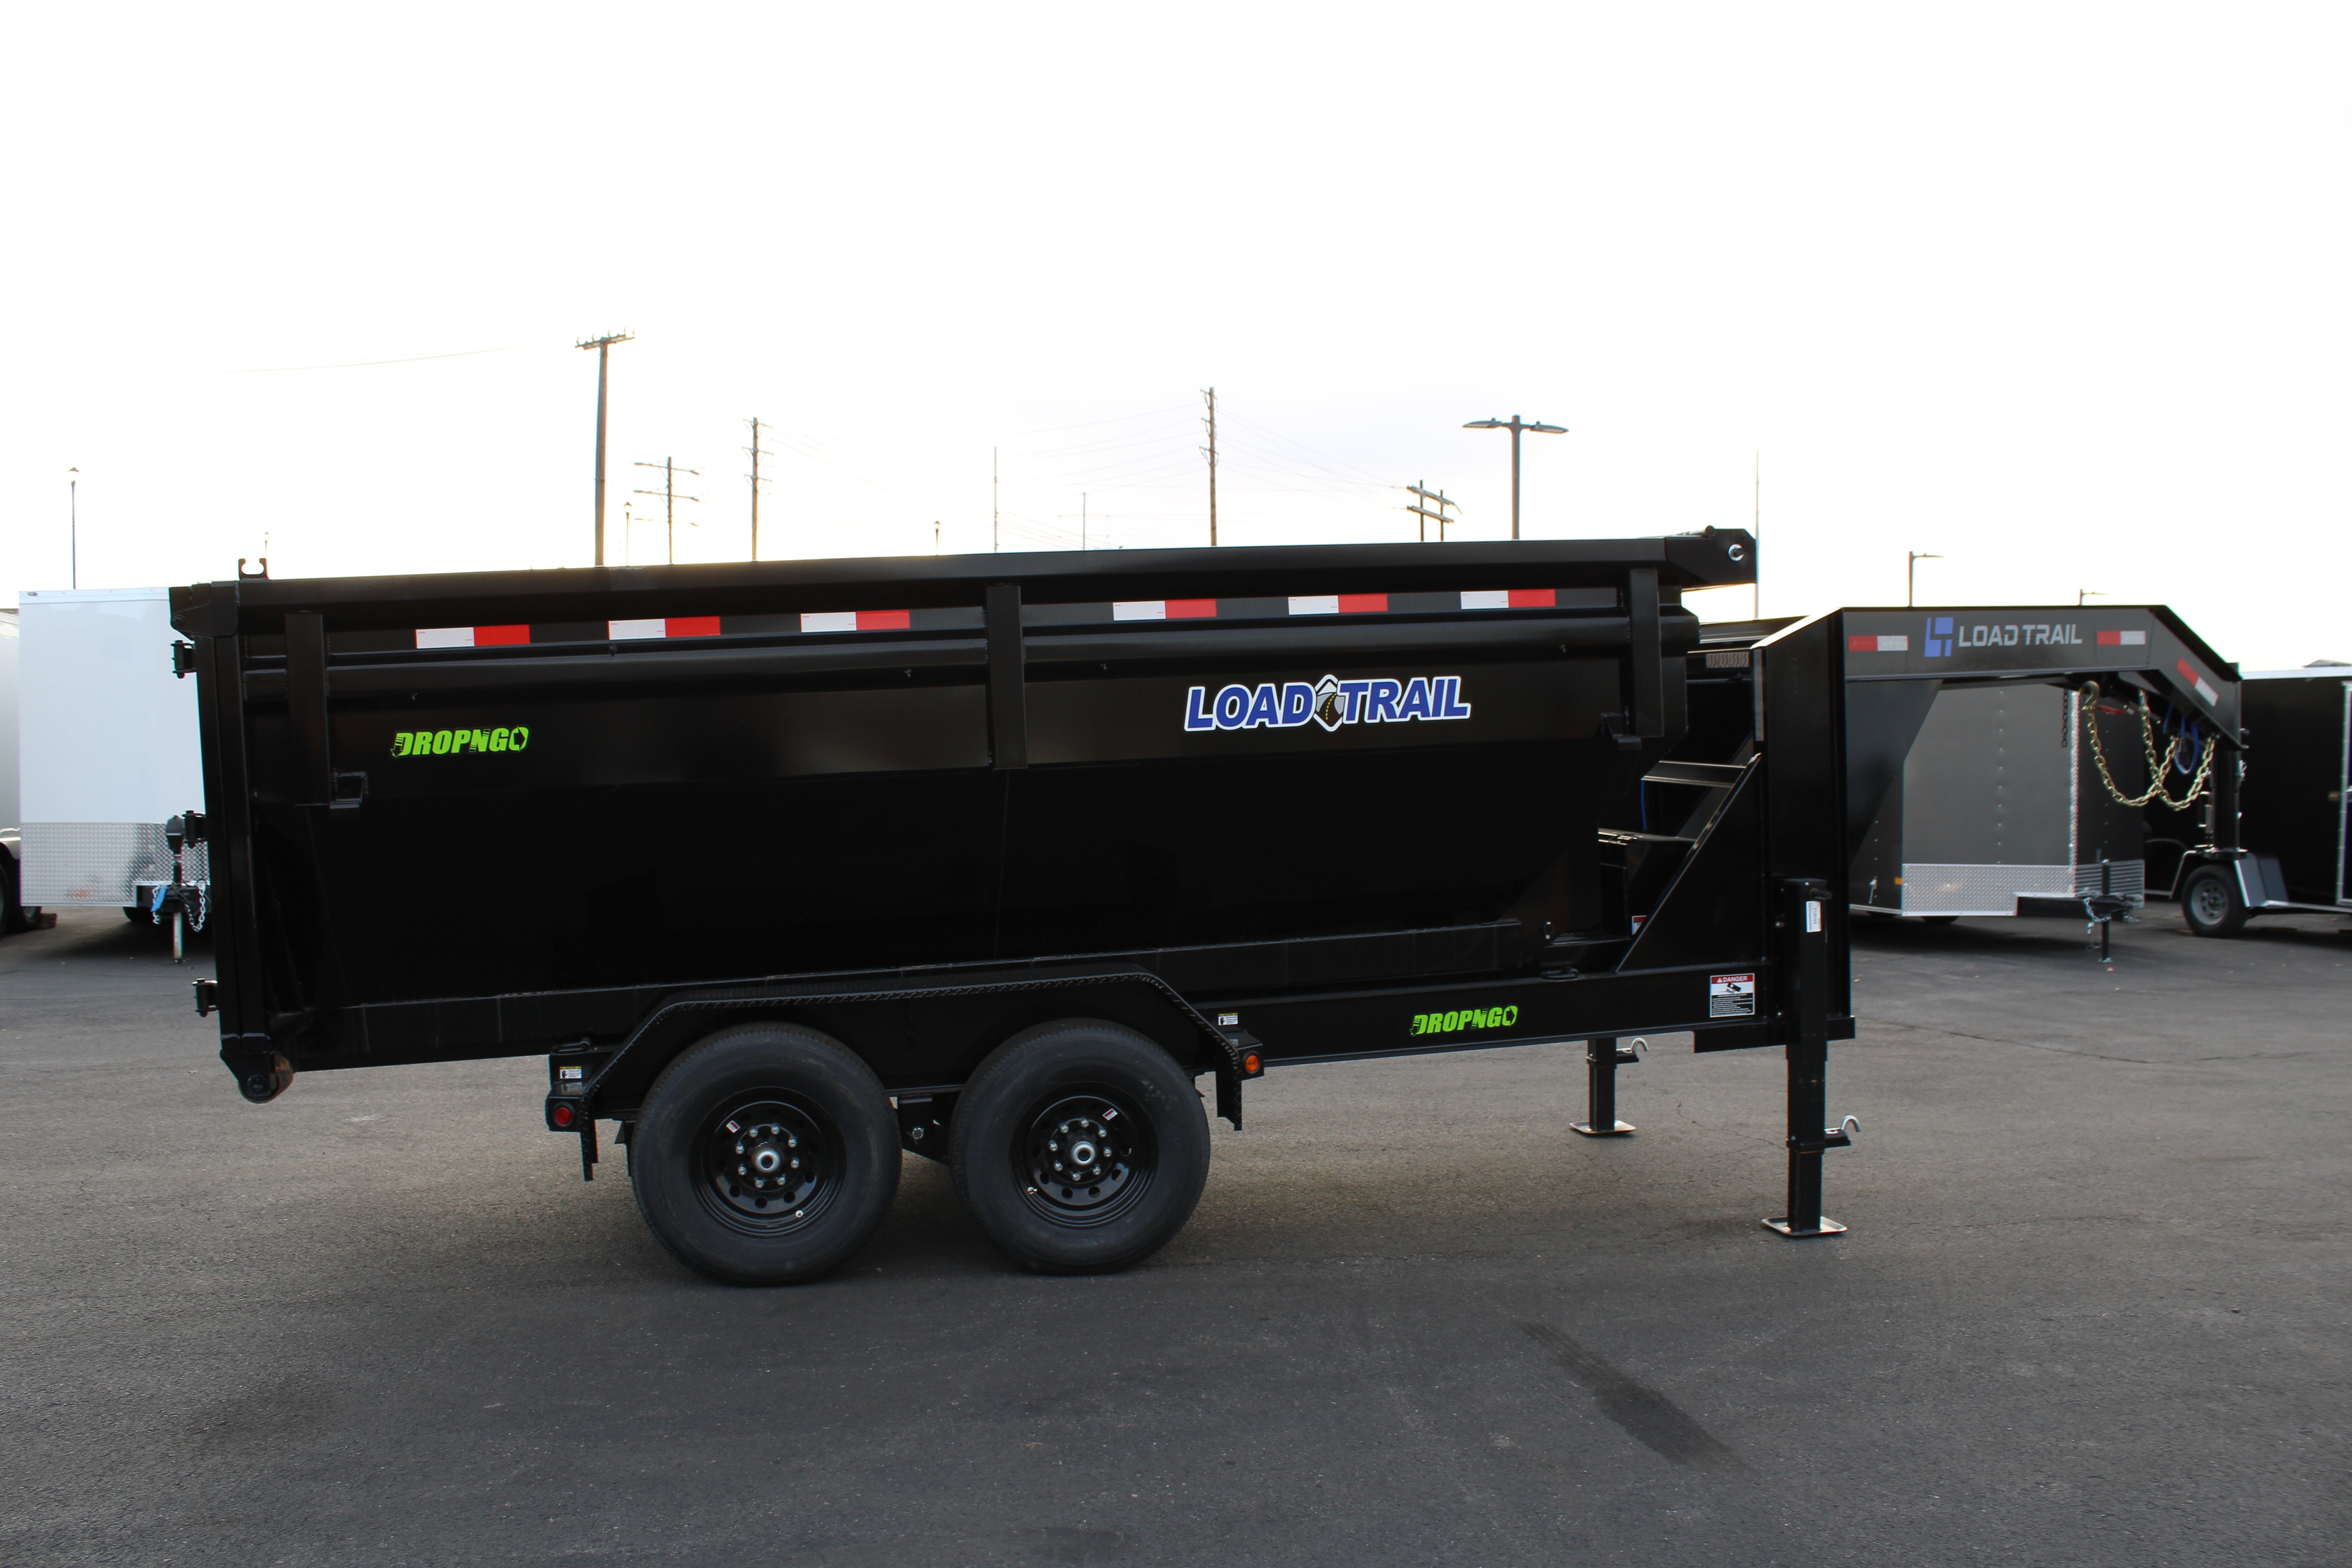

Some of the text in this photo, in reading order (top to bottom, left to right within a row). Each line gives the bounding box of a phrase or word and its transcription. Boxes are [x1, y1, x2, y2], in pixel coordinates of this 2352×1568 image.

[1959, 624, 2082, 647] LOAD TRAIL
[1184, 676, 1471, 731] LOAD TRAIL
[390, 726, 529, 758] DROPNGO
[1410, 1005, 1518, 1036] DROPNGO
